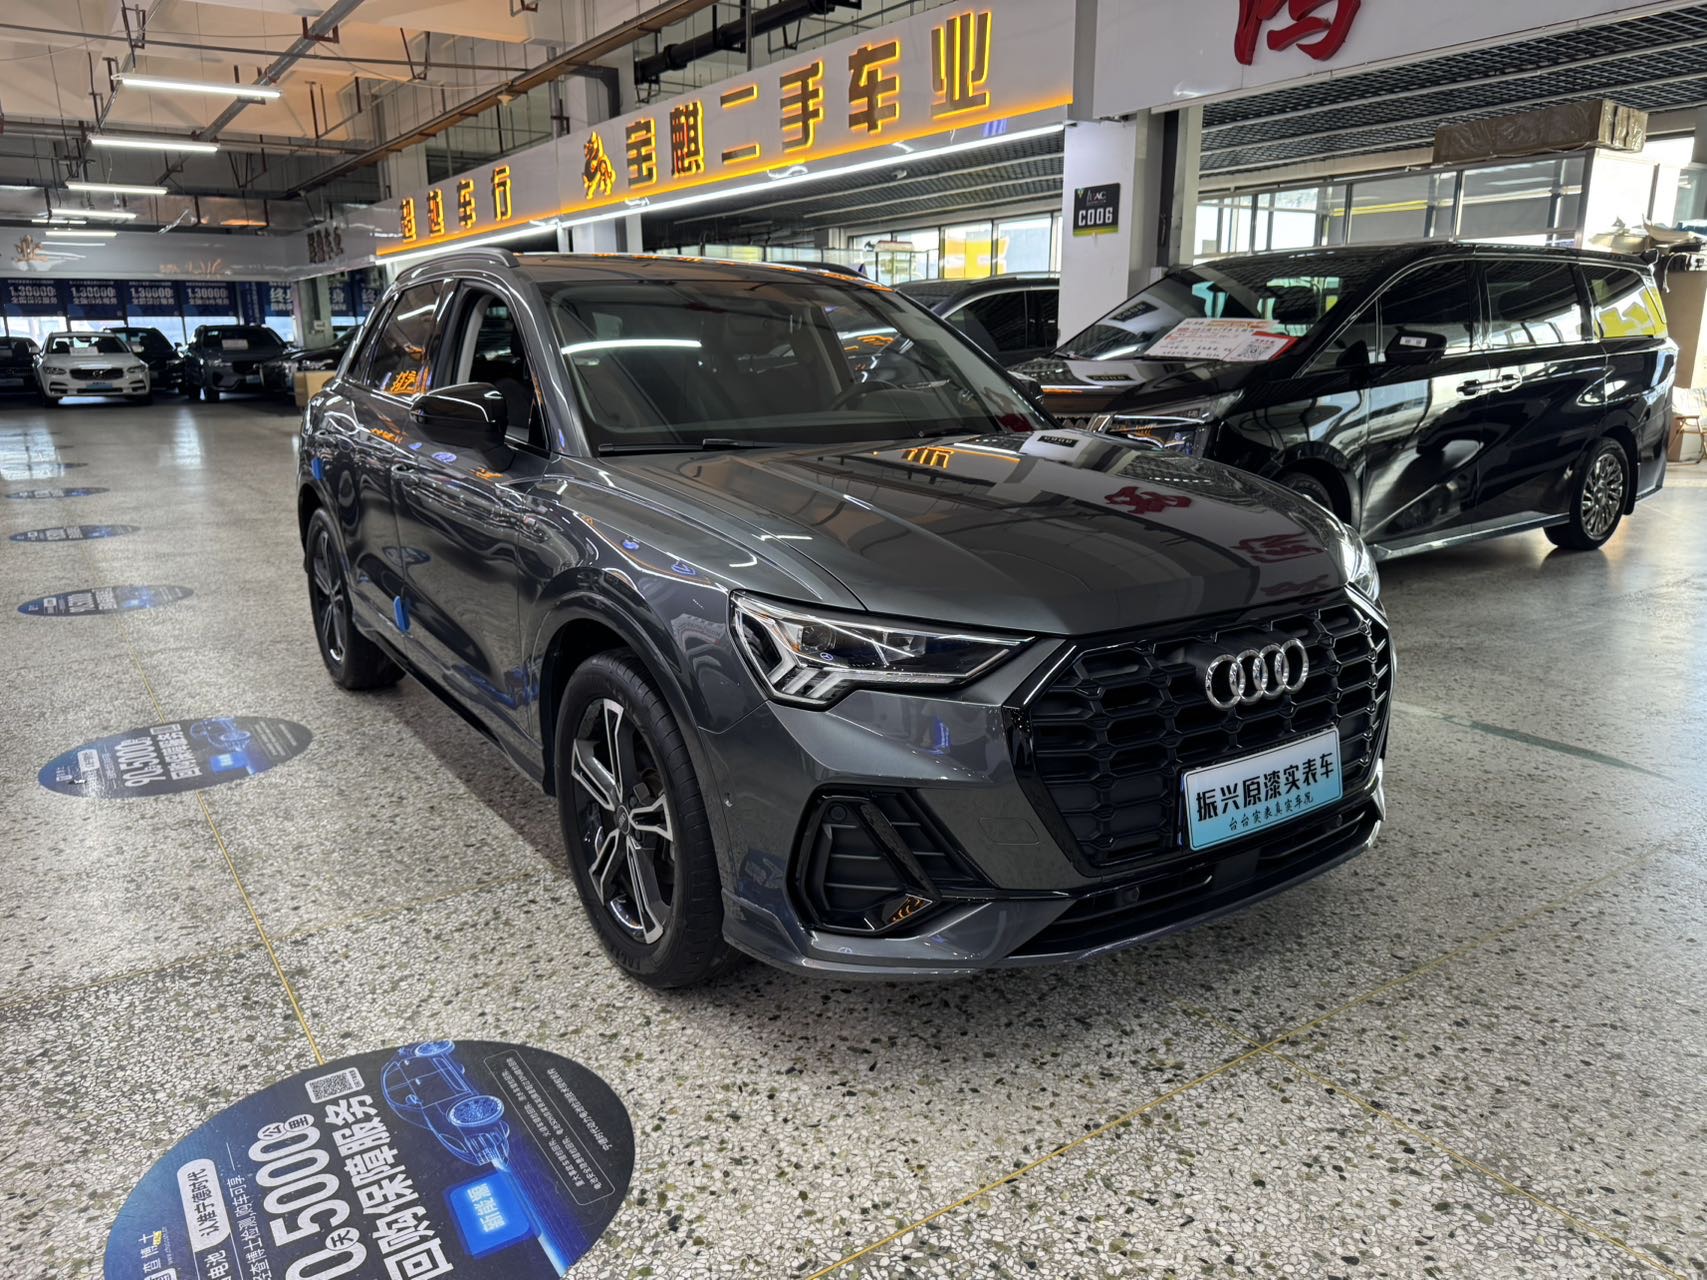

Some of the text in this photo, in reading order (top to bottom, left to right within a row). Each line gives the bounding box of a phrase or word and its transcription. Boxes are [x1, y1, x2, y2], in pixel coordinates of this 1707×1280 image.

[1078, 207, 1113, 227] C006
[1195, 752, 1335, 822] 振兴原漆实表车
[185, 1165, 220, 1238] 认准宁德时代
[323, 1093, 455, 1280] 回购保障服务
